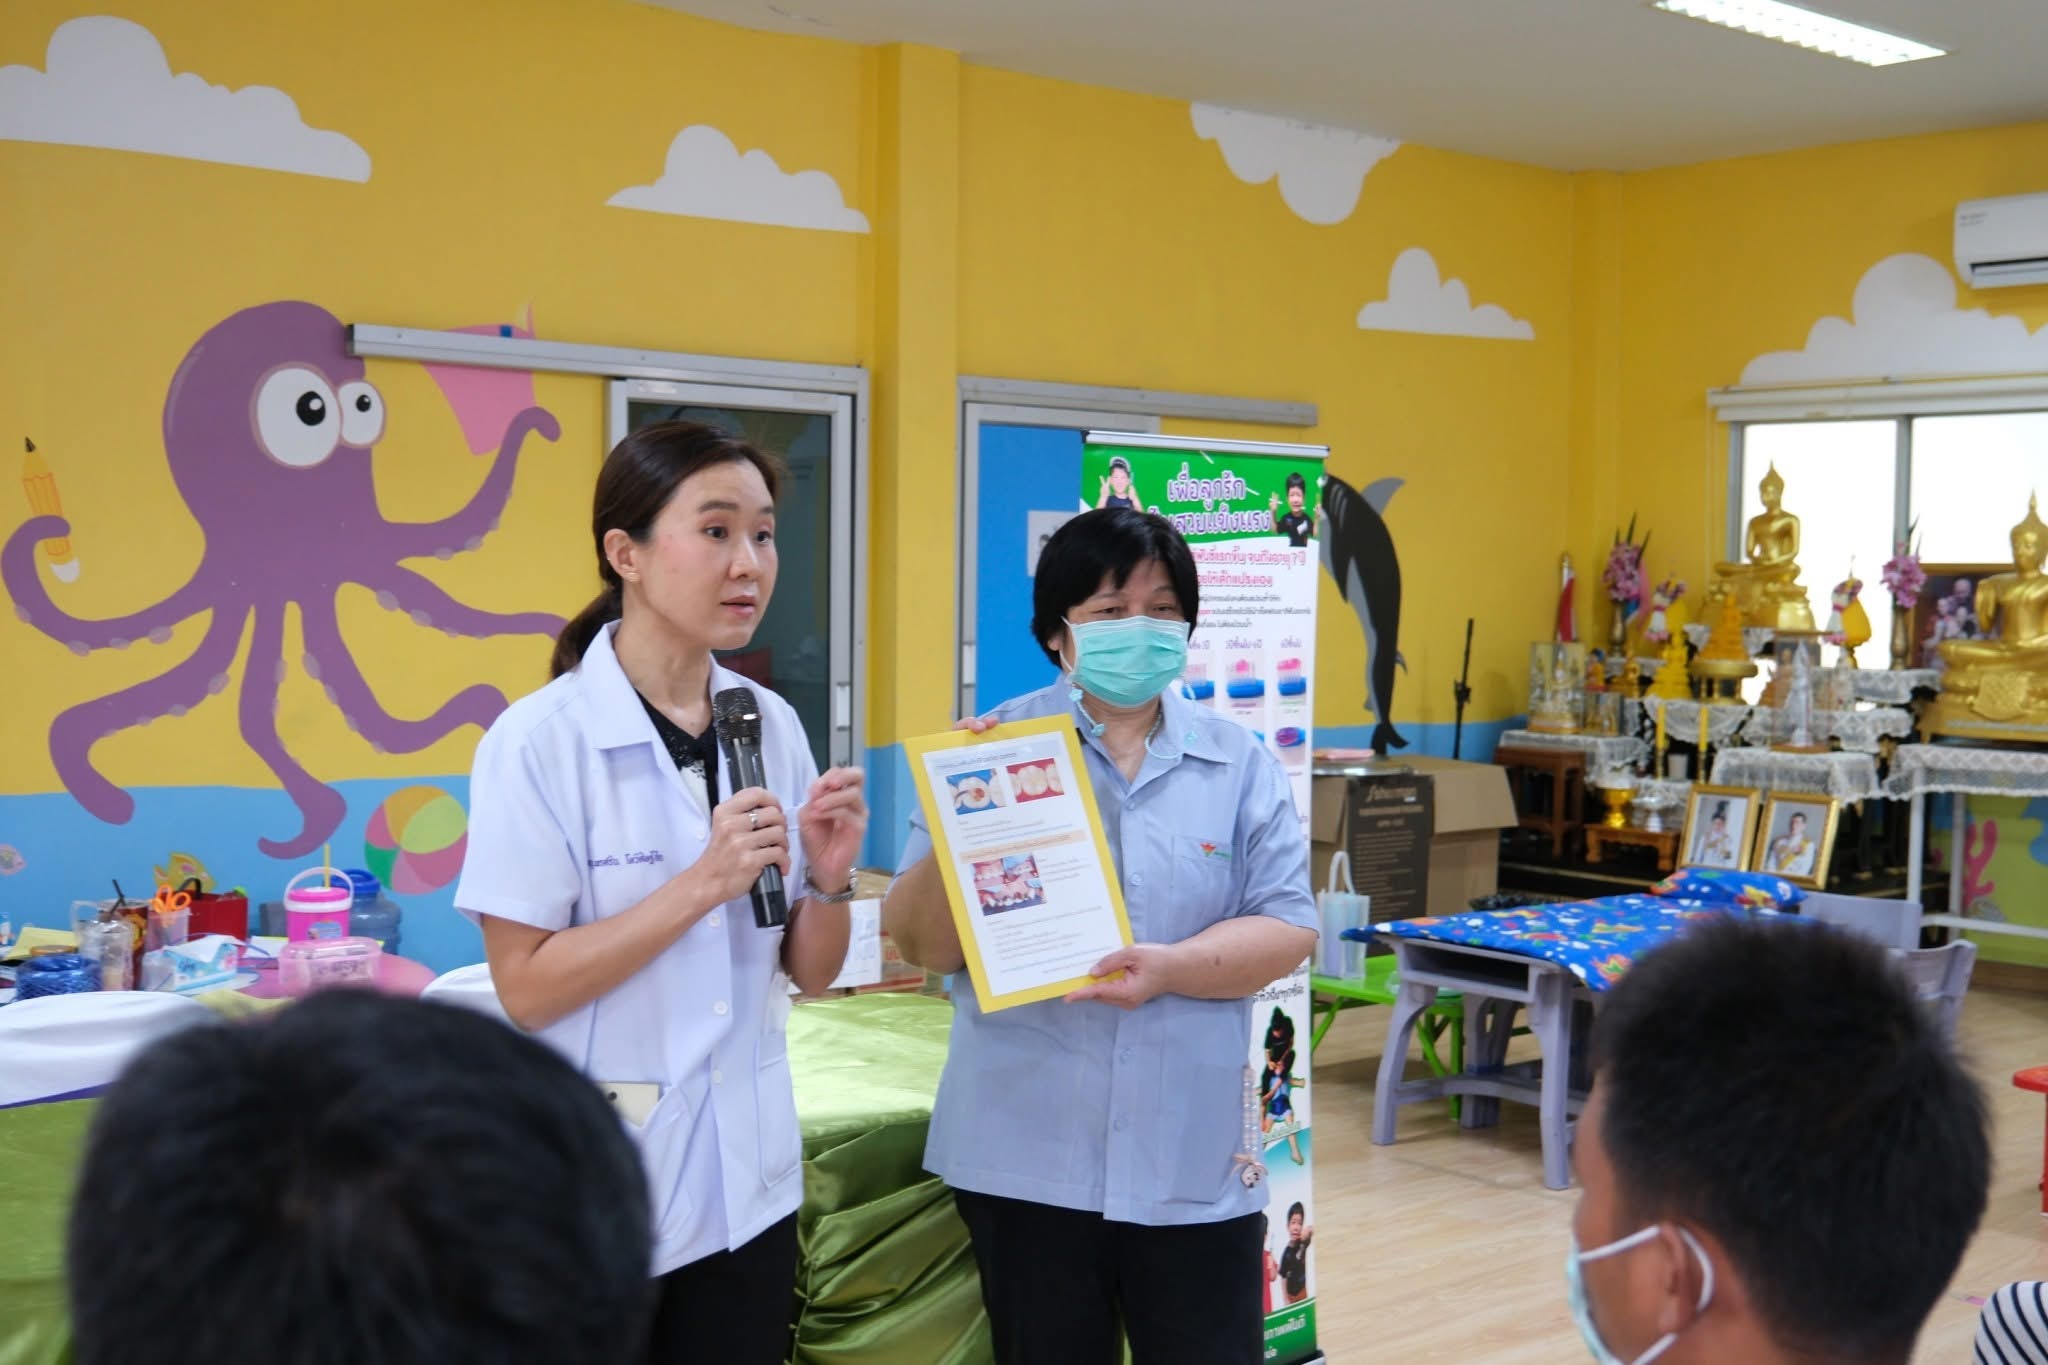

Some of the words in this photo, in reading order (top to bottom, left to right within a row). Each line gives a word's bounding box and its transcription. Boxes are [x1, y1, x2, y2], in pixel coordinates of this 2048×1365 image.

[1168, 463, 1246, 510] เพื่อลูกรัก
